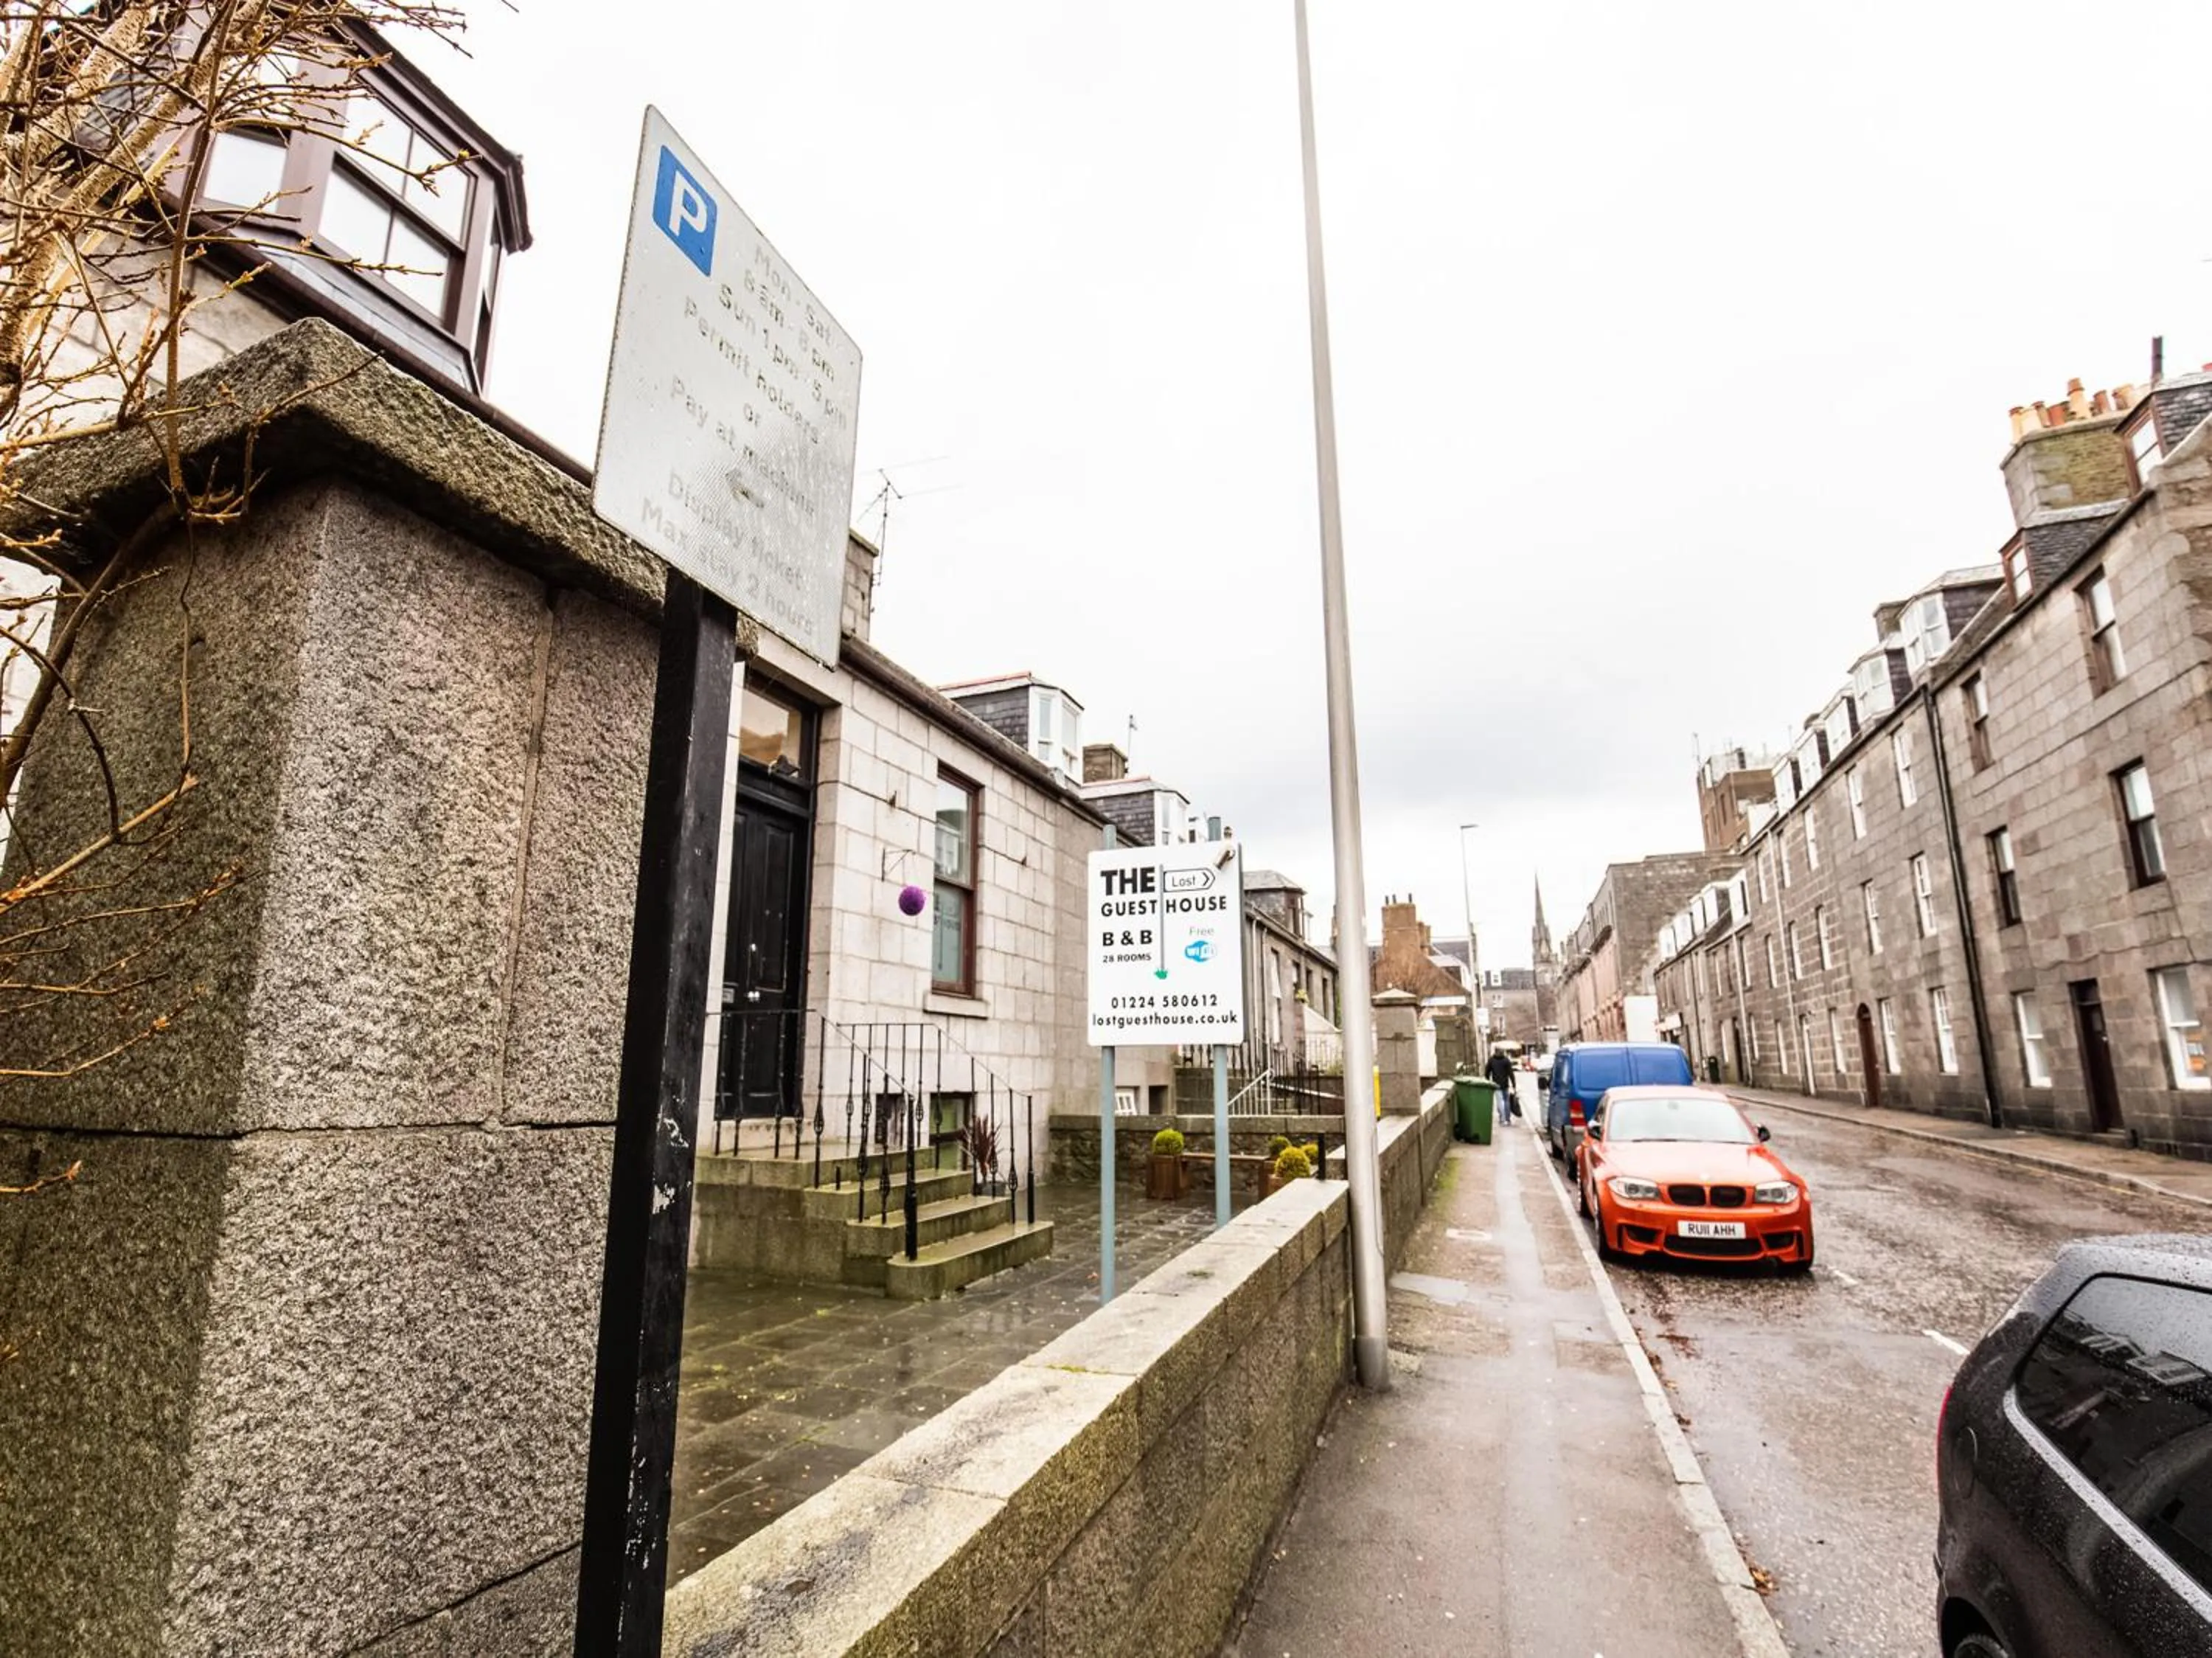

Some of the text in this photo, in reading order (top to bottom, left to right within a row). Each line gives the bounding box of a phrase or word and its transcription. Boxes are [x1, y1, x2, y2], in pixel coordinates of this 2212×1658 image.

[669, 170, 709, 237] P
[684, 296, 818, 445] Permit holders
[670, 375, 709, 429] Pay
[716, 421, 735, 451] at
[743, 403, 761, 428] or
[642, 497, 688, 549] Max
[748, 573, 759, 598] 2
[765, 585, 813, 635] hours
[1100, 867, 1196, 896] THE Lost
[1101, 895, 1227, 917] GUEST HOUSE
[1189, 926, 1214, 936] Free
[1102, 953, 1152, 963] 28 ROOMS
[1111, 993, 1218, 1009] 01224 580612
[1093, 1010, 1238, 1029] lostguesthouse.co.uk
[1713, 1224, 1736, 1236] AHH
